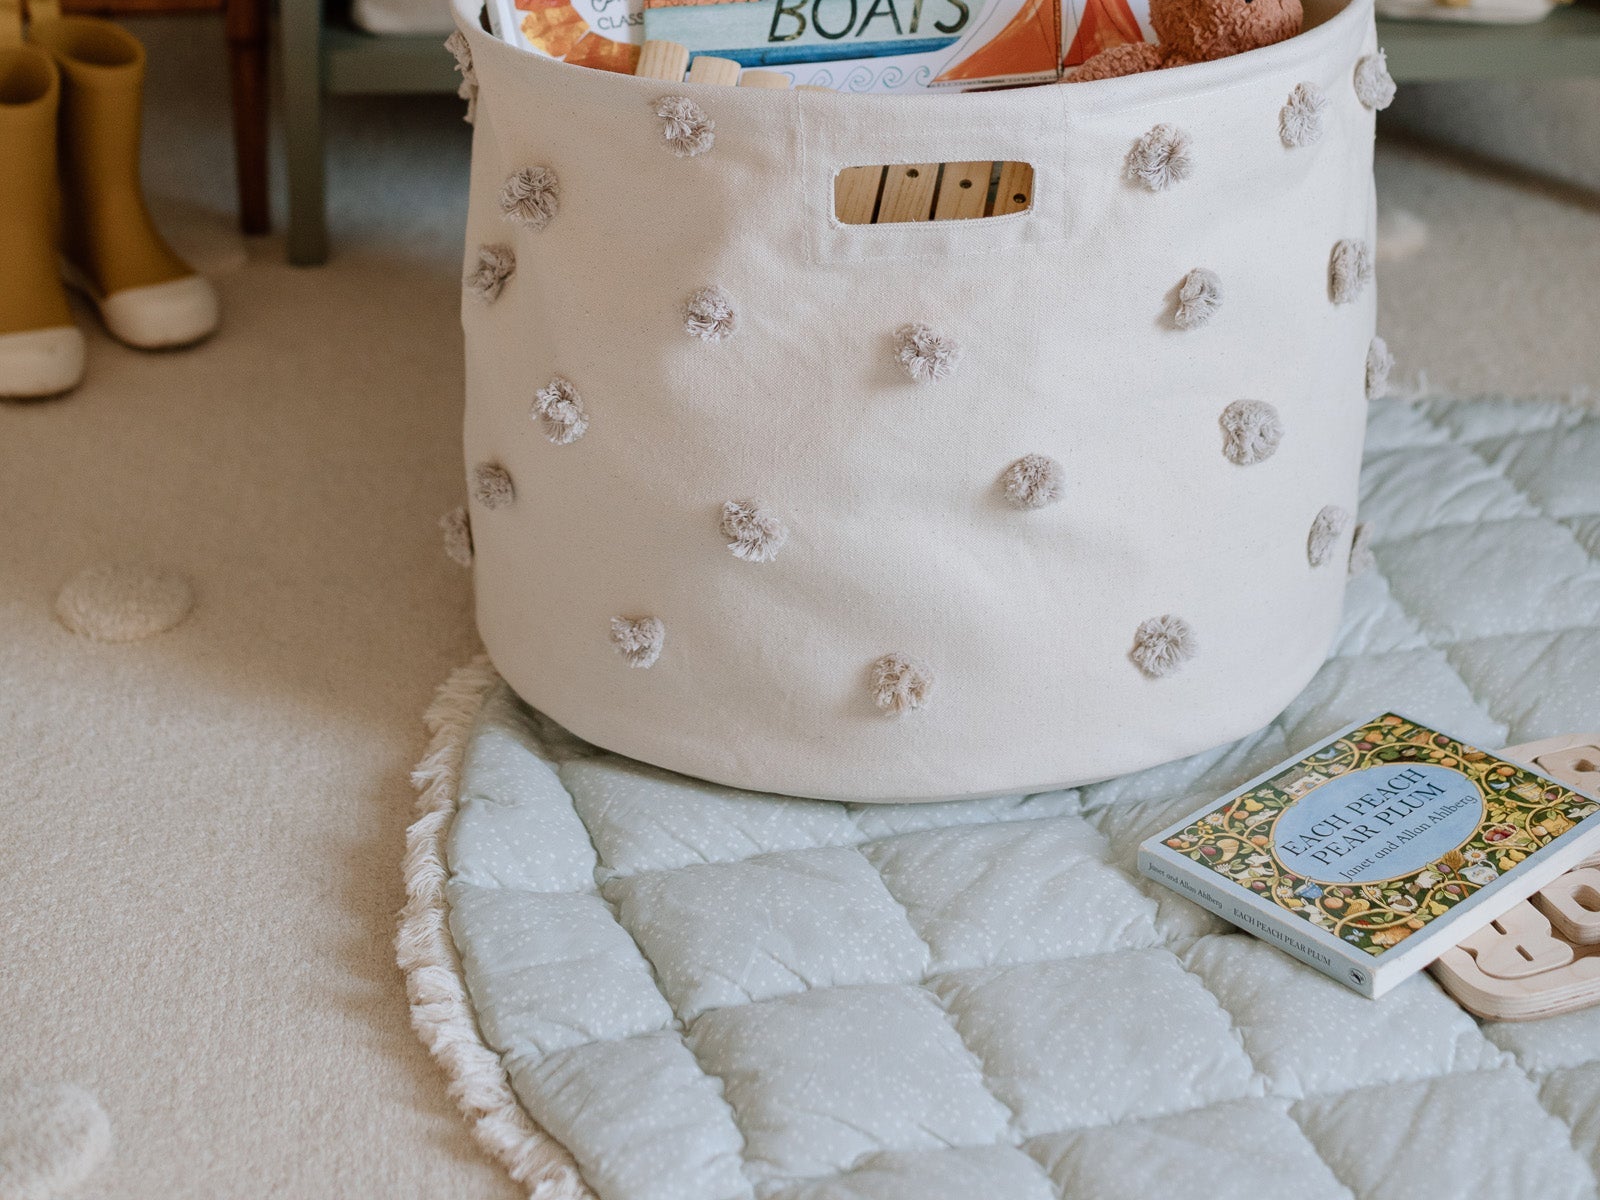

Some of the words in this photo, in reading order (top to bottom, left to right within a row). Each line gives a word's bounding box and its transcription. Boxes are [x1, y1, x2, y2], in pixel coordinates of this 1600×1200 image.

[1280, 813, 1352, 857] EACH
[1345, 768, 1427, 816] PEACH
[1311, 824, 1380, 866] PEAR
[1374, 782, 1447, 826] PLUM
[1339, 857, 1375, 881] Janet
[1375, 841, 1400, 859] and
[1398, 821, 1431, 845] Allan
[1429, 794, 1478, 825] Ahlberg
[1148, 862, 1166, 877] Janet
[1166, 872, 1179, 885] and
[1179, 878, 1197, 895] Allan
[1197, 889, 1223, 910] Ahlberg
[1233, 907, 1255, 925] EACH
[1256, 920, 1284, 941] PEACH
[1285, 936, 1306, 954] PEAR
[1306, 948, 1332, 967] PLUM
